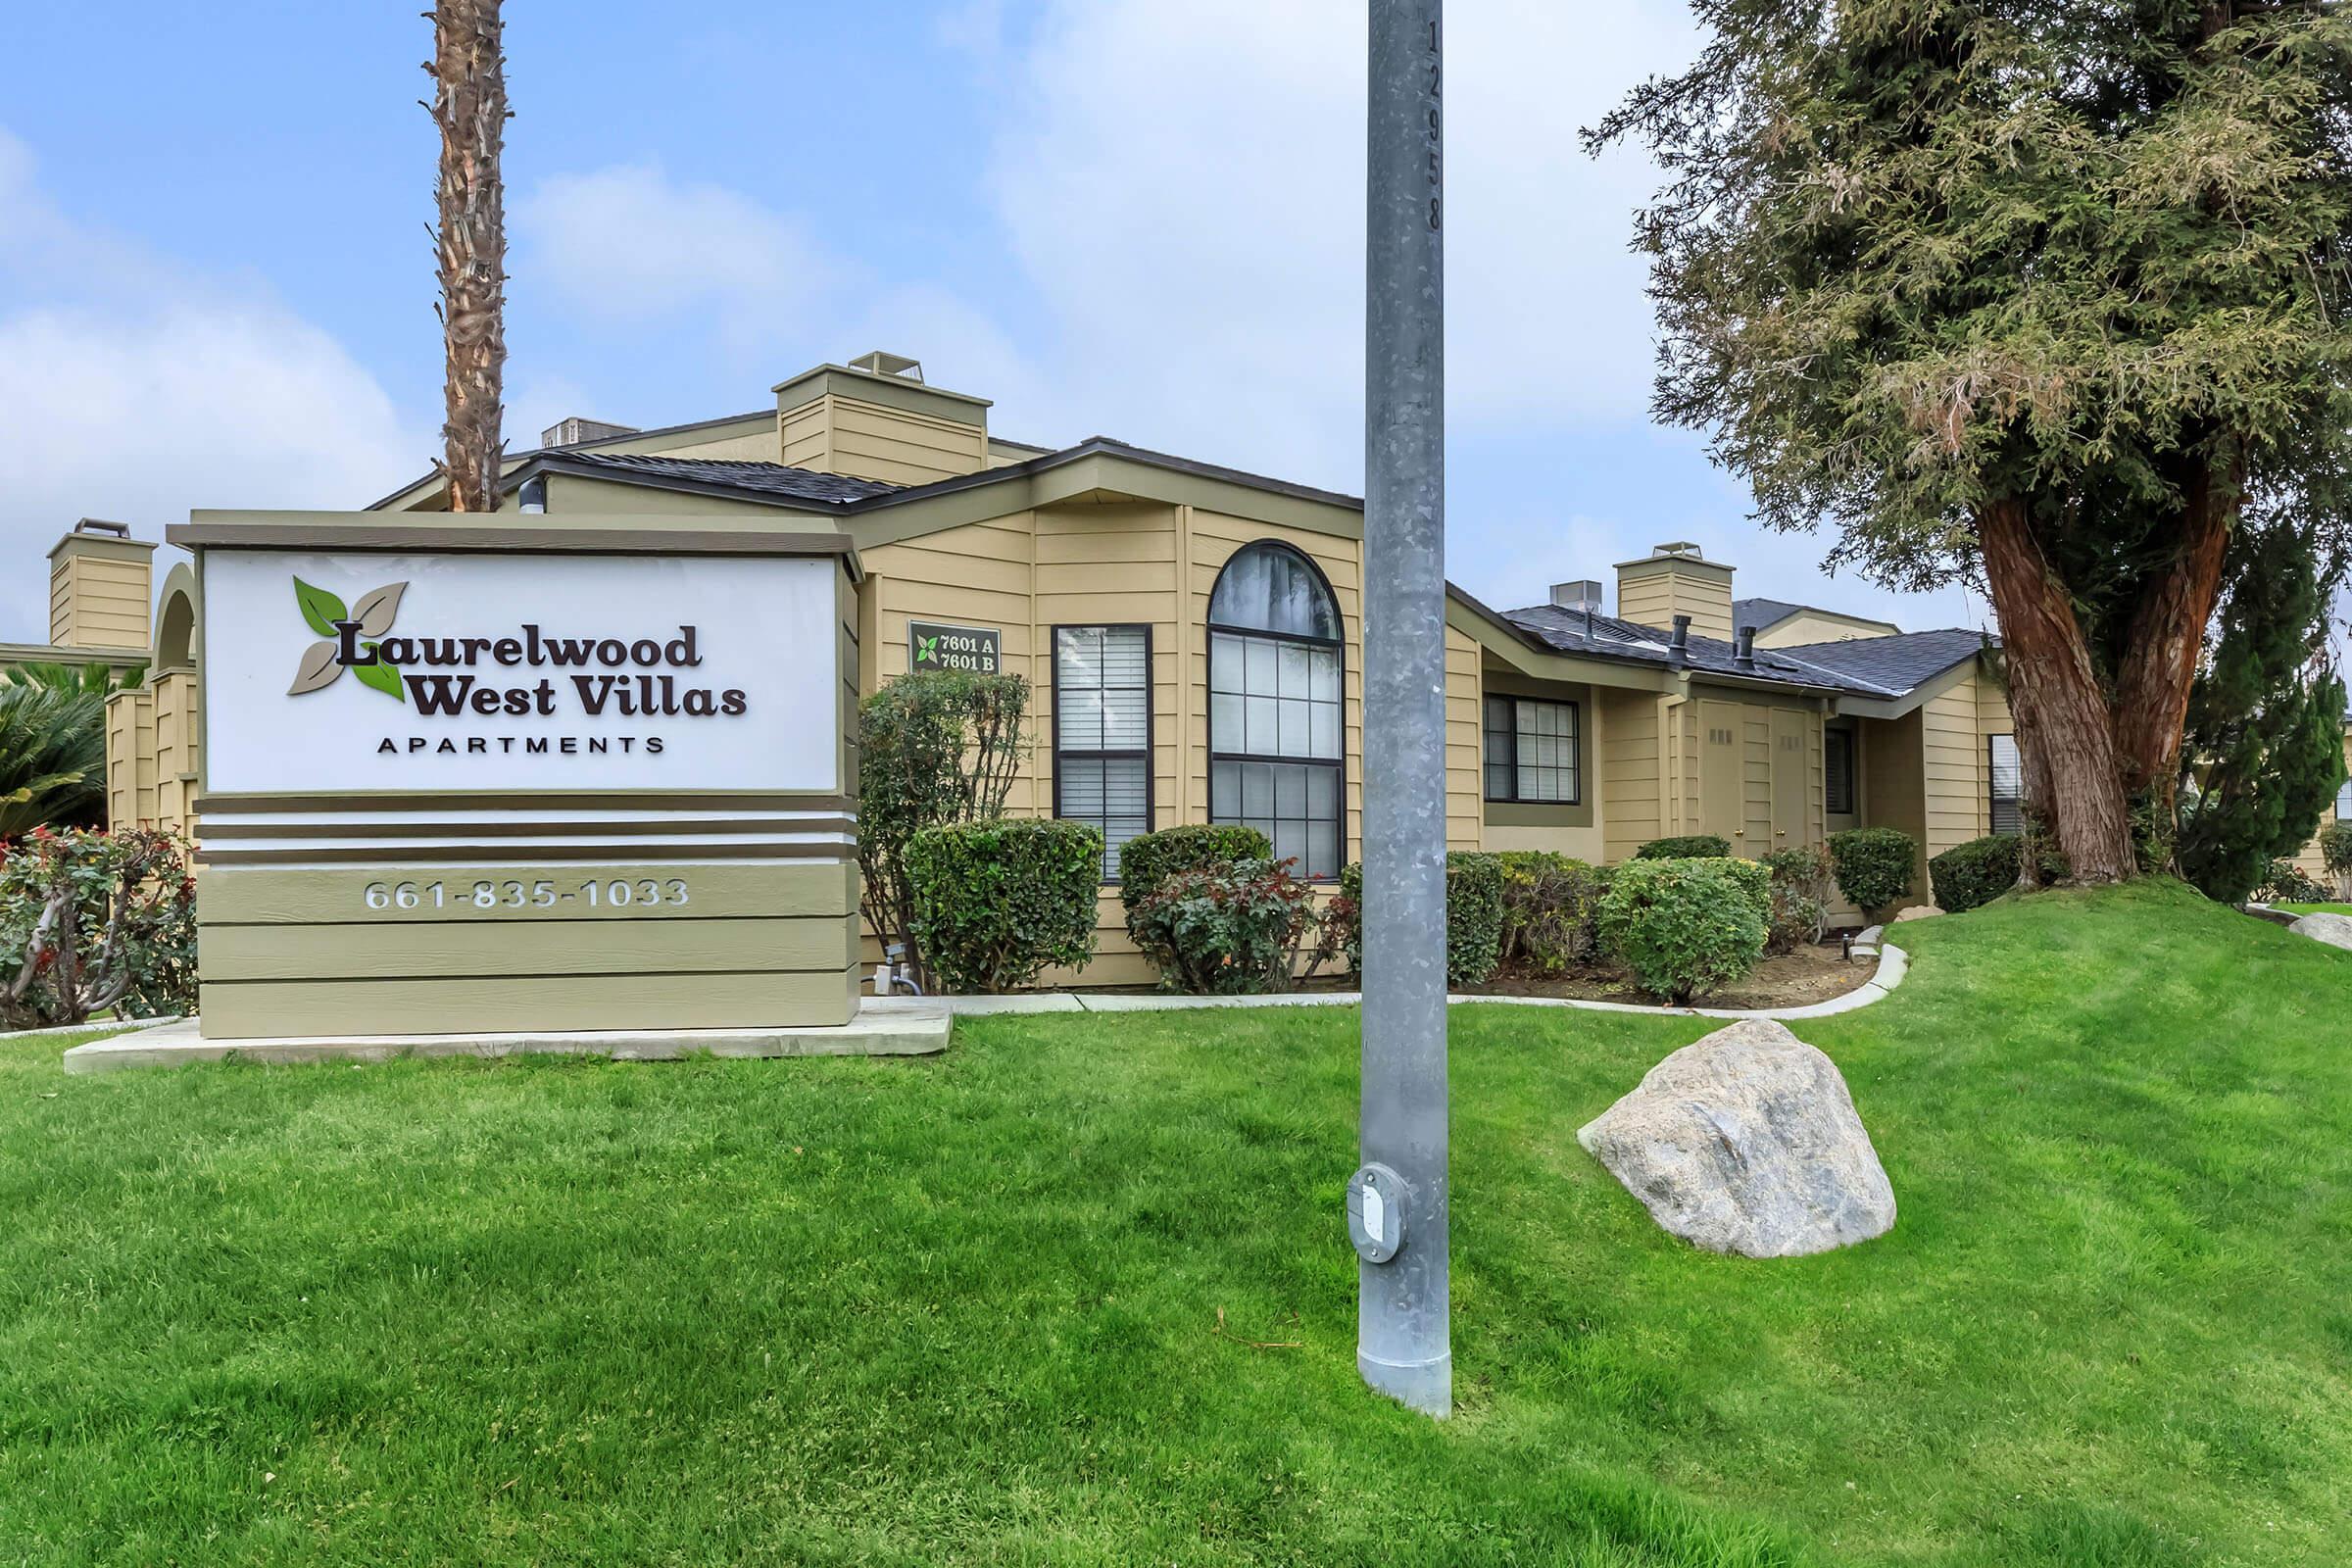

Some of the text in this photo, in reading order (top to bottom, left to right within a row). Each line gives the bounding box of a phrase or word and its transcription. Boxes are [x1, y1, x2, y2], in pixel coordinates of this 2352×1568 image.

[1429, 21, 1440, 230] 12958
[335, 622, 703, 666] Laurelwood
[940, 635, 994, 654] 7601 A
[941, 654, 994, 670] 7601 B
[403, 674, 747, 715] West Villas
[377, 737, 663, 754] APARTMENTS
[364, 879, 689, 907] 661-835-1033
